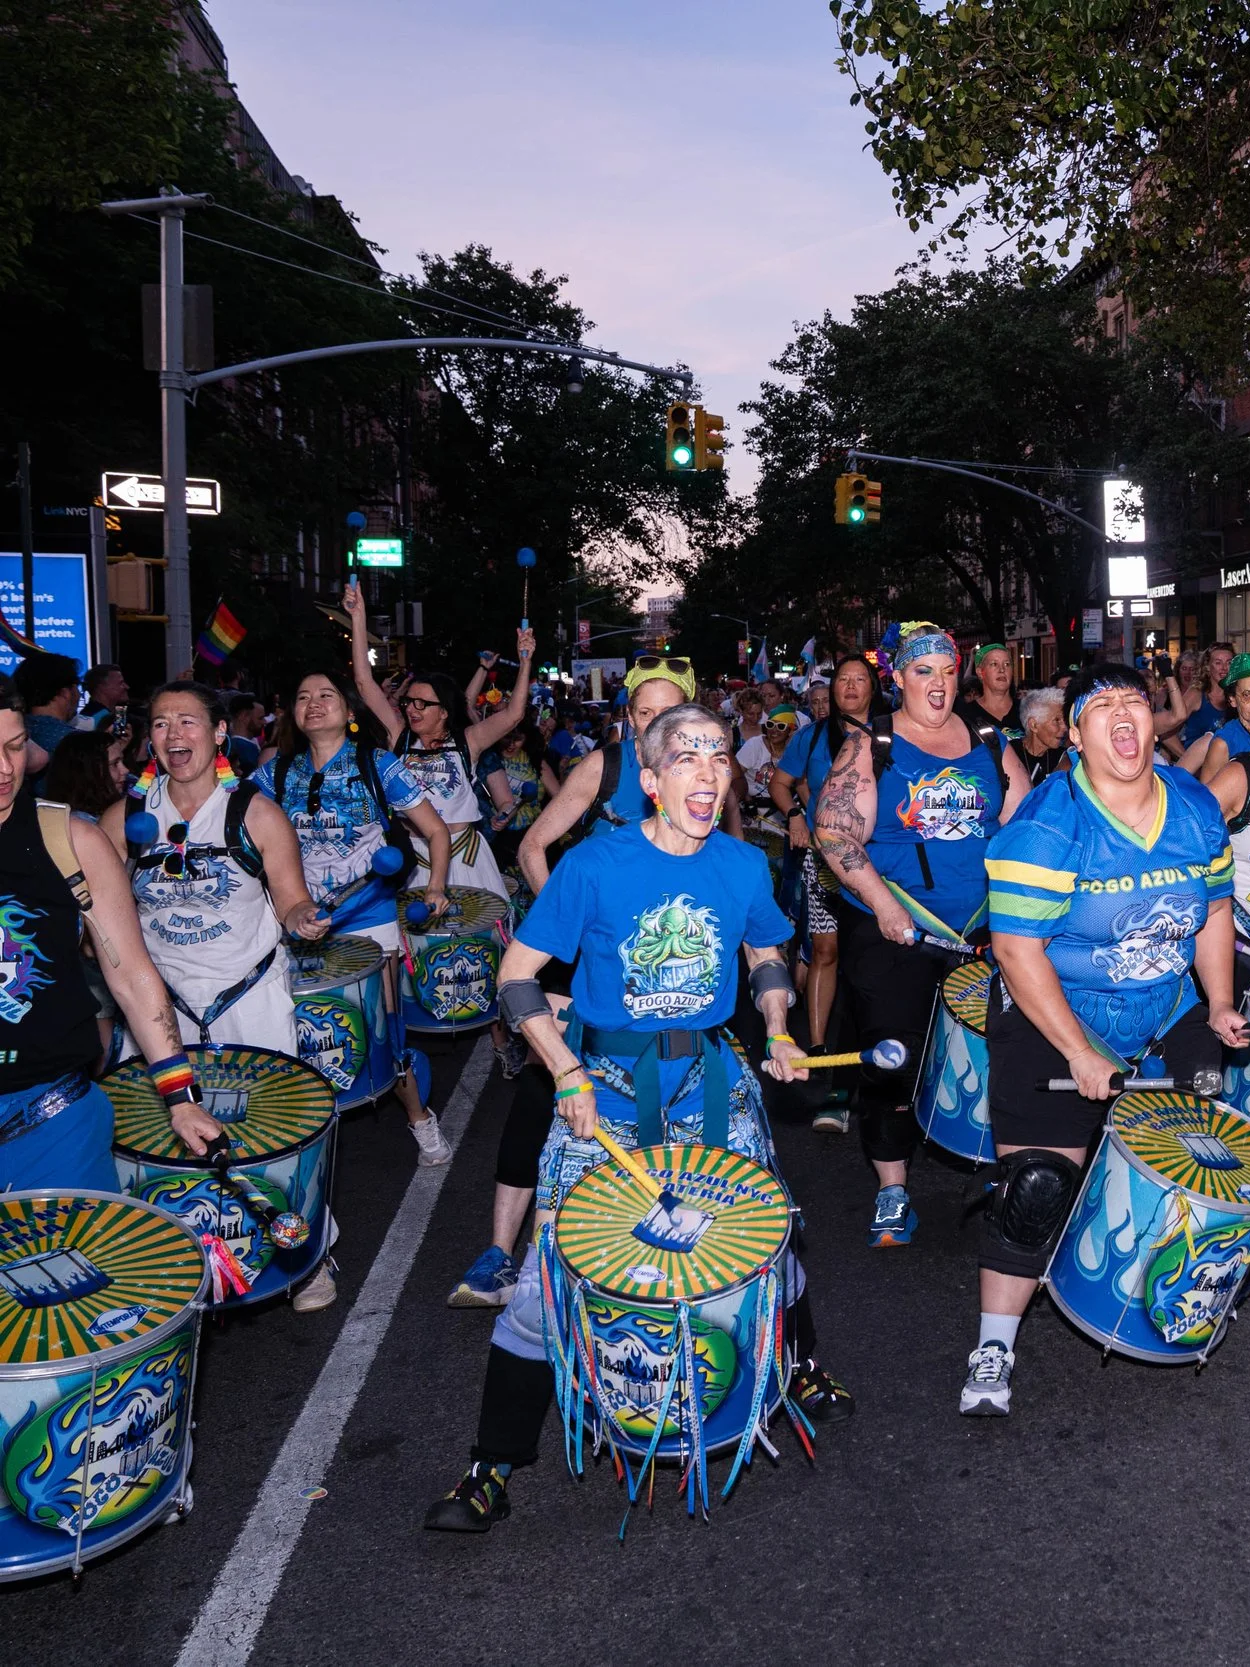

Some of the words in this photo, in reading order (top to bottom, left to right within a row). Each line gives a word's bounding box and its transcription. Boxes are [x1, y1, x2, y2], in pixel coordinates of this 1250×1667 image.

[127, 486, 160, 499] ONE
[1080, 875, 1135, 894] FOGO
[1141, 866, 1188, 890] AZUL
[150, 918, 232, 946] DRUMLINE
[168, 912, 204, 930] NYC
[1113, 950, 1144, 982] FOGO
[1163, 950, 1187, 975] AZUL
[471, 992, 489, 1012] AZUL
[639, 996, 671, 1008] FOGO
[674, 996, 698, 1006] AZUL
[322, 1065, 351, 1088] AZUL
[660, 1182, 736, 1207] ATERIA
[678, 1171, 730, 1190] AZUL
[735, 1182, 774, 1206] NYC
[33, 1201, 98, 1223] NYC
[1167, 1306, 1208, 1341] FOGO
[69, 1475, 121, 1534] FOGO
